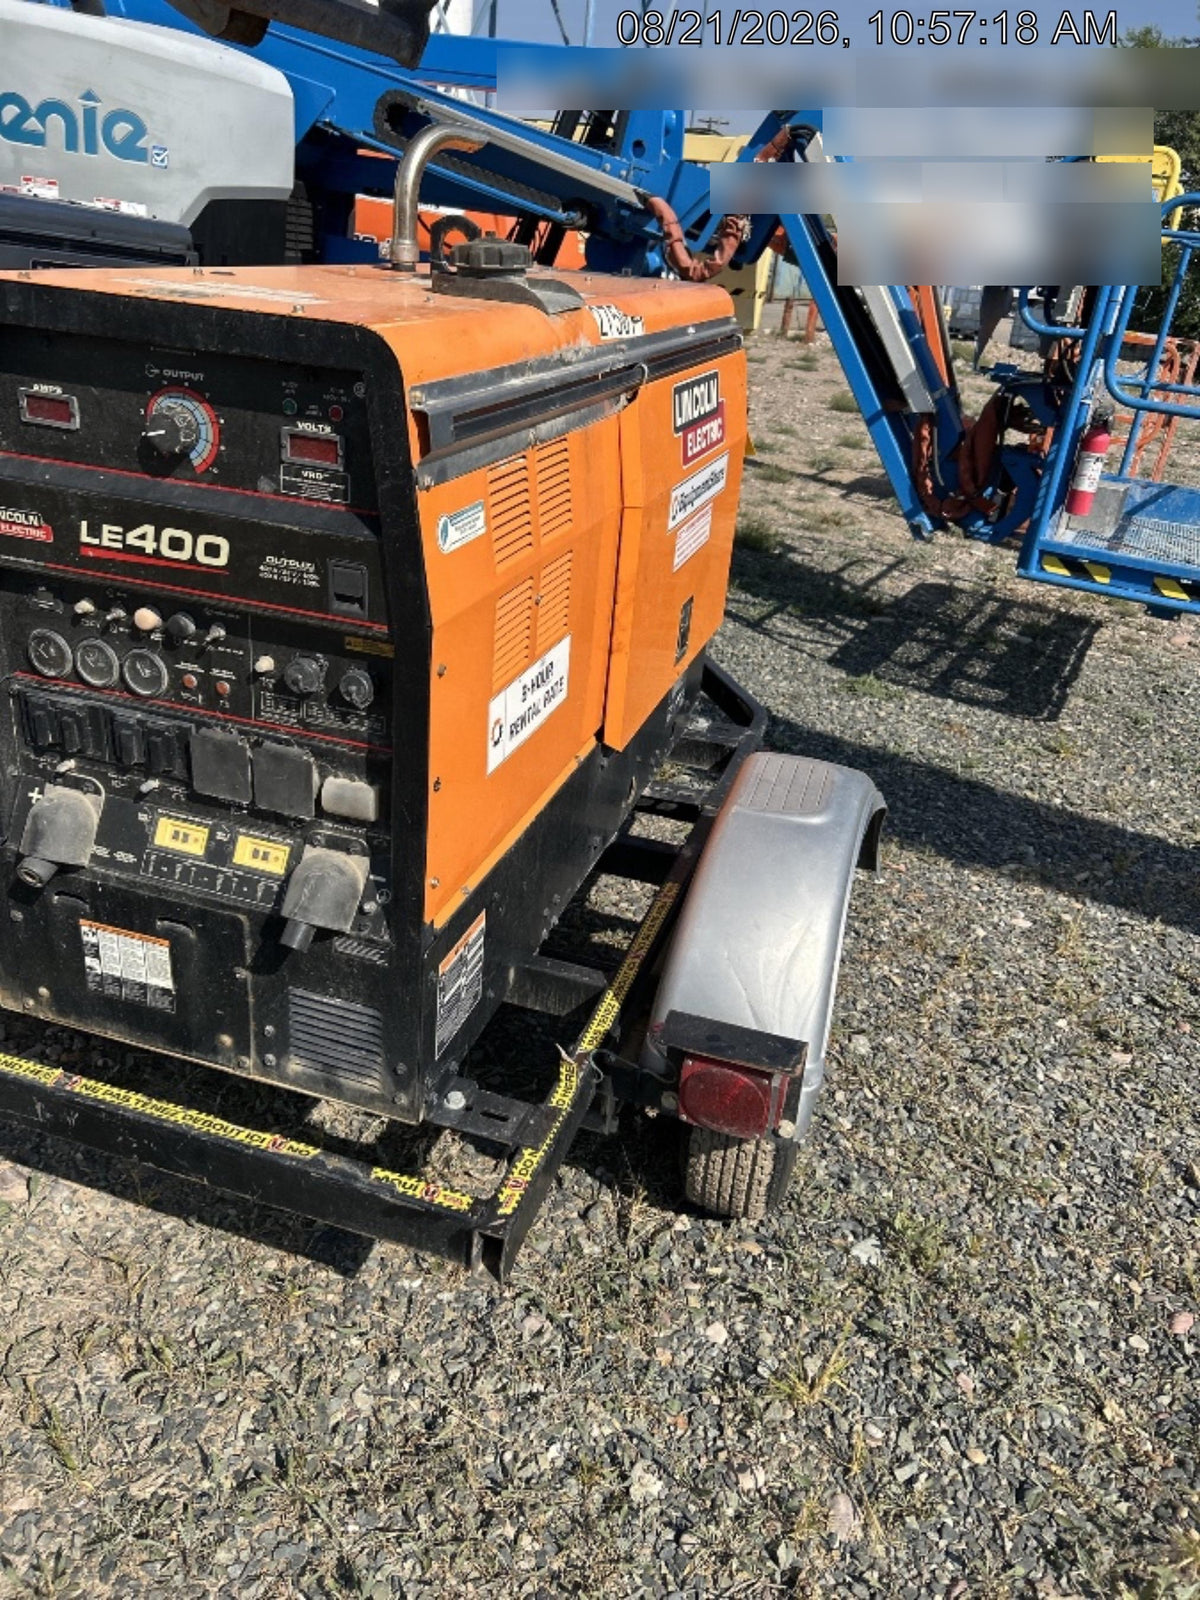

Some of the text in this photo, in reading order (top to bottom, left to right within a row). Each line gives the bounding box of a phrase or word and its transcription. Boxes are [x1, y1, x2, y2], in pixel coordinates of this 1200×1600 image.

[32, 383, 63, 395] AMPS
[163, 369, 205, 382] OUTPUT
[675, 378, 718, 428] LINCOLN
[296, 421, 332, 434] VOLTS
[687, 416, 723, 458] ELECTRIC
[79, 520, 230, 567] LE400
[508, 675, 565, 742] RENTAL RATE
[80, 1083, 100, 1095] NE
[102, 1088, 131, 1104] PAS
[182, 1111, 243, 1139] DEBOUT
[245, 1131, 266, 1145] ICI
[286, 1144, 311, 1157] NO
